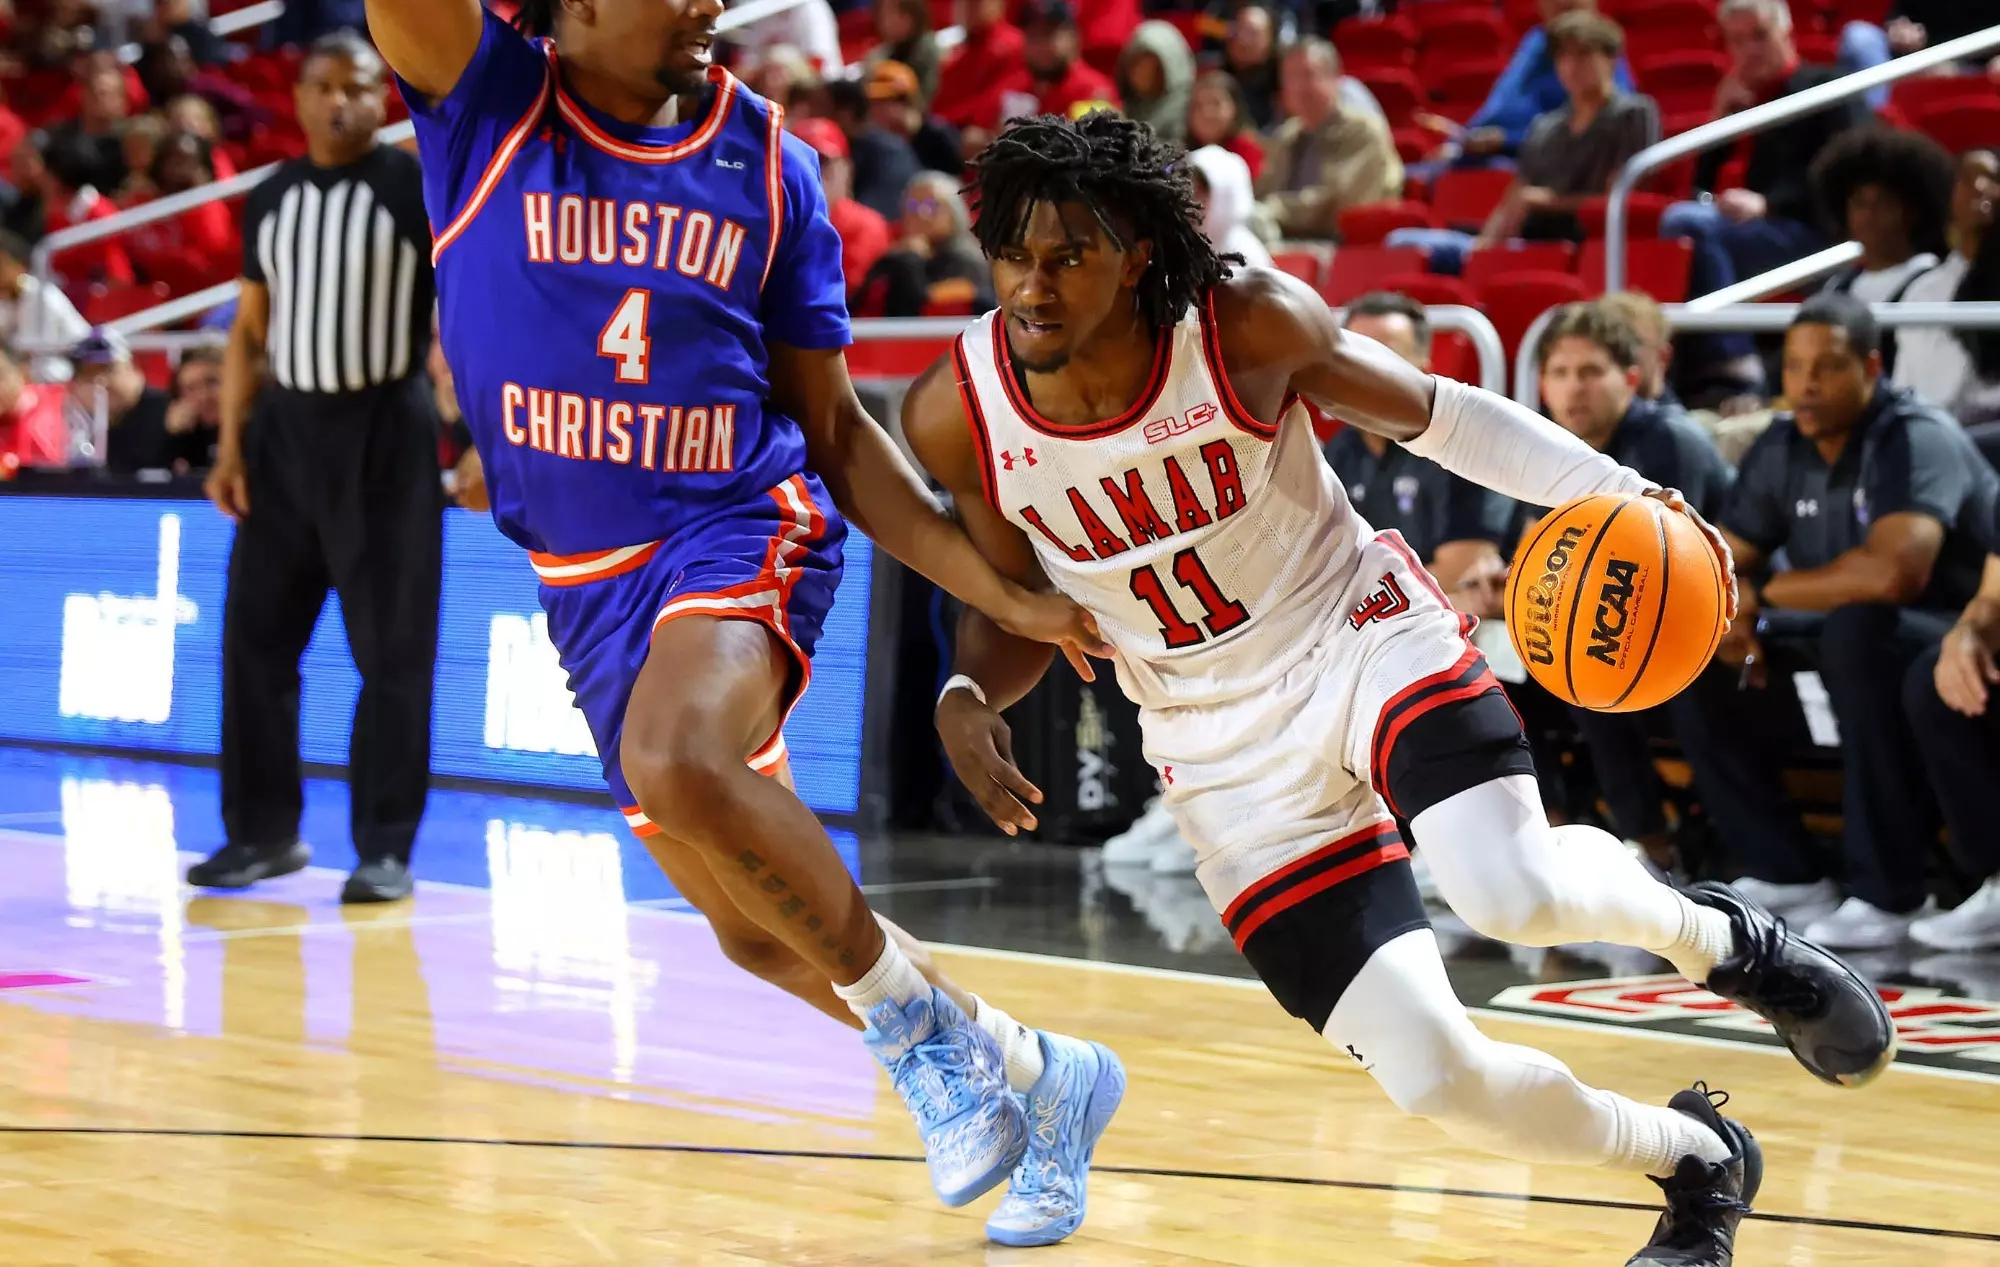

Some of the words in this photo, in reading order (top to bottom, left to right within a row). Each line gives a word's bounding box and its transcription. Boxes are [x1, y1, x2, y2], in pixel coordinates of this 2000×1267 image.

[523, 192, 747, 291] HOUSTON
[597, 287, 651, 384] 4
[502, 381, 736, 473] CHRISTIAN
[1143, 402, 1217, 445] SLC
[1019, 438, 1247, 562] LAMAR
[1129, 546, 1251, 649] 11
[1524, 525, 1589, 666] Wilson
[1586, 558, 1640, 667] NCAA
[1619, 627, 1635, 670] OFFICIAL
[1630, 594, 1643, 626] GAME
[1638, 565, 1650, 593] BALL
